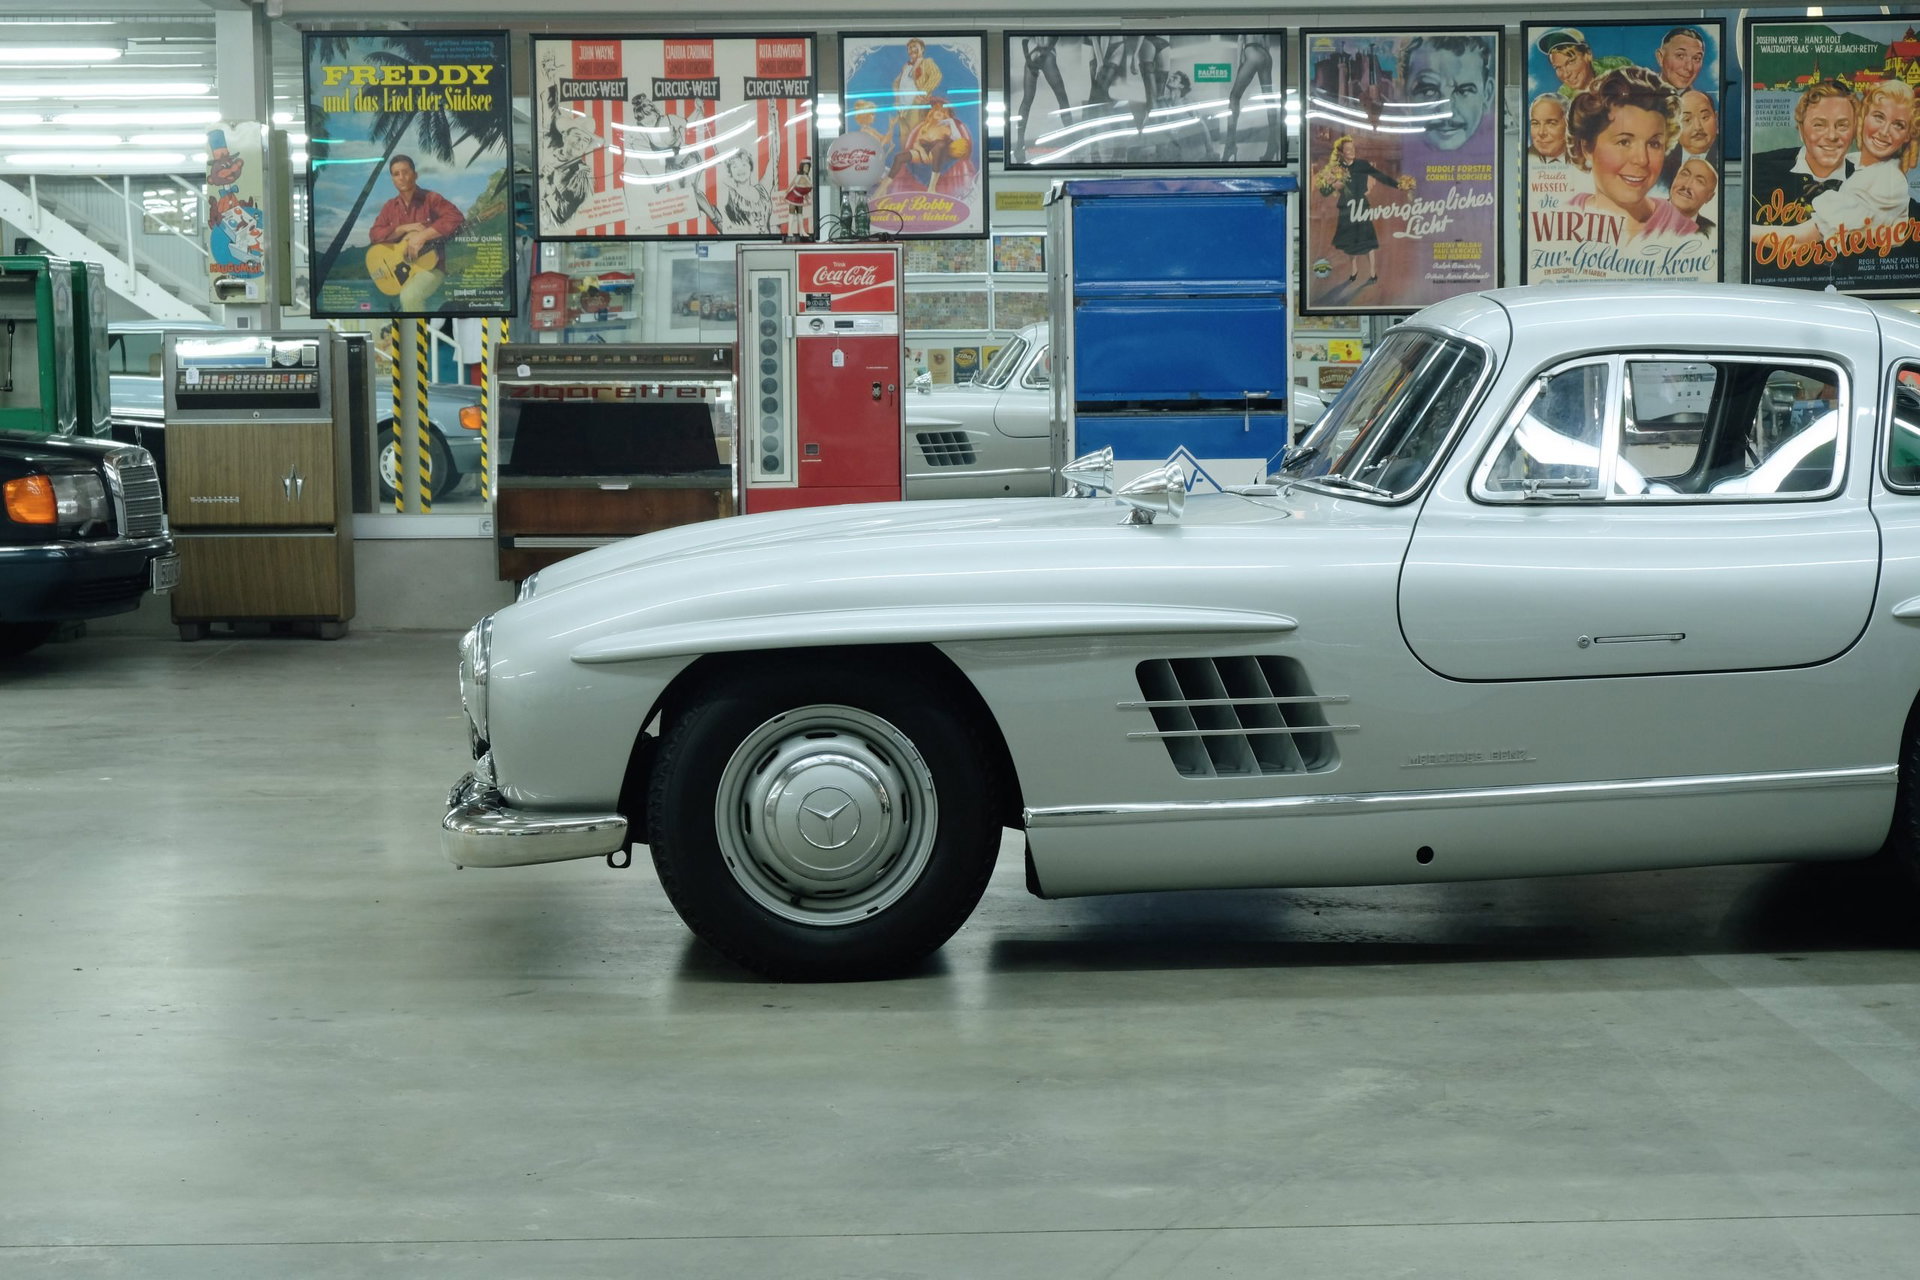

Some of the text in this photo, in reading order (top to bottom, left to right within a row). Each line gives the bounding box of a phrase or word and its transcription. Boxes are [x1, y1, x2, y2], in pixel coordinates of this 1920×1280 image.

[1779, 36, 1798, 44] KIPPER
[1804, 36, 1822, 44] HANS
[1825, 36, 1841, 44] HOLT
[579, 45, 614, 60] JOHN WAYNE
[759, 44, 802, 59] RITA HAYWORTH
[1761, 44, 1878, 53] WALTRAUT HAAS WOLF ALBACH-RETTY
[322, 65, 493, 85] FREDDY
[323, 86, 492, 112] und das Lied der Südsee
[1457, 164, 1492, 172] FORSTER
[1538, 170, 1566, 180] Paula
[1532, 183, 1568, 192] WESSELY
[910, 196, 954, 212] Bobby
[1347, 186, 1494, 223] Unvergängliches
[1392, 215, 1453, 239] Licht
[1531, 211, 1626, 246] WIRTIN
[1756, 217, 1920, 270] Obersteiger
[813, 266, 878, 287] Coca-Cola
[510, 384, 721, 400] zigaretten
